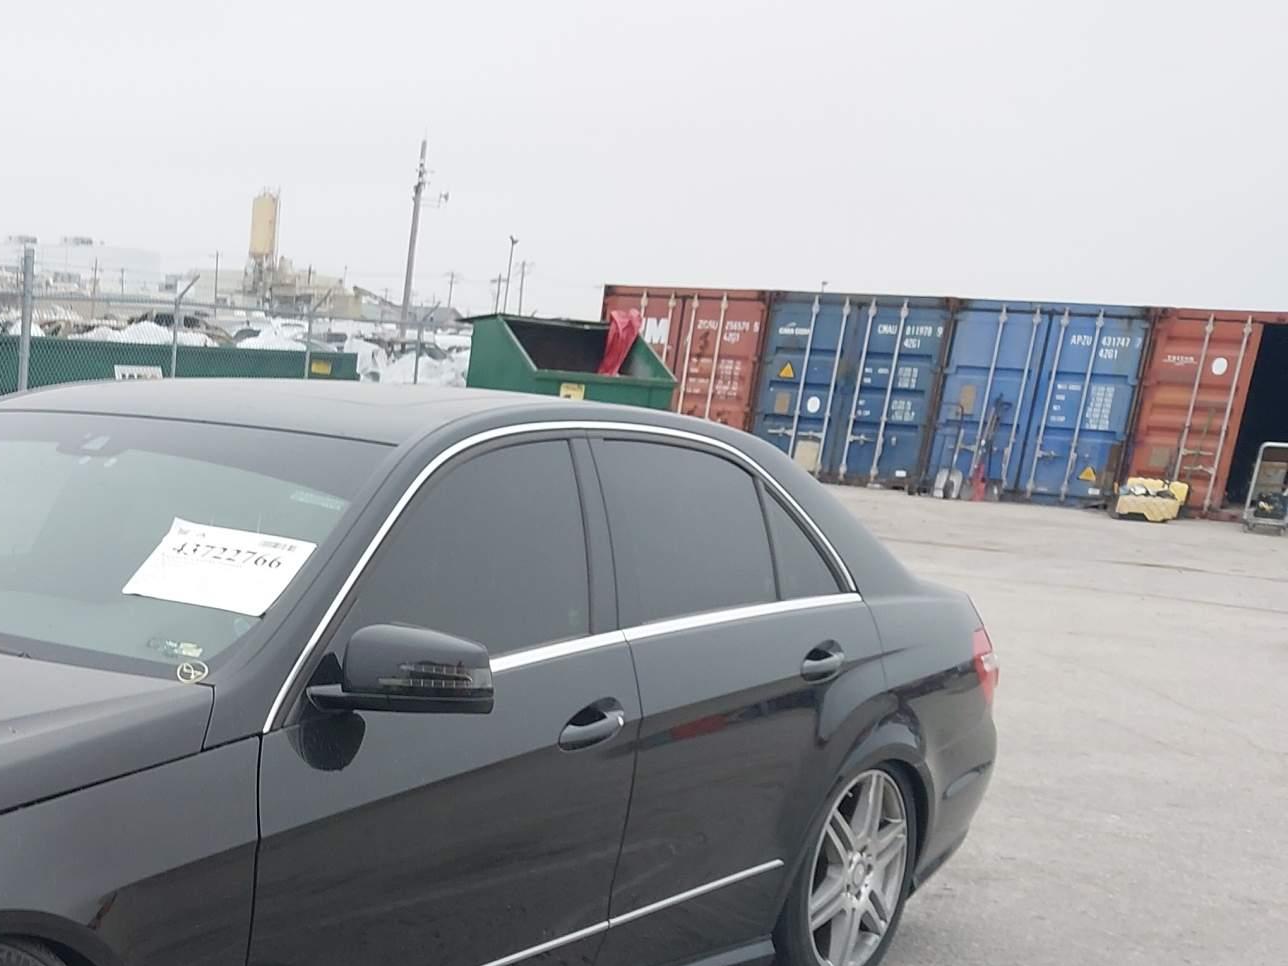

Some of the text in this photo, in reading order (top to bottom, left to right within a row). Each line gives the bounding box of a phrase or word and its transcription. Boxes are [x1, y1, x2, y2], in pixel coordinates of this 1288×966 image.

[1070, 334, 1093, 346] APZU
[1101, 336, 1131, 348] 431747
[172, 541, 283, 569] 43722766
